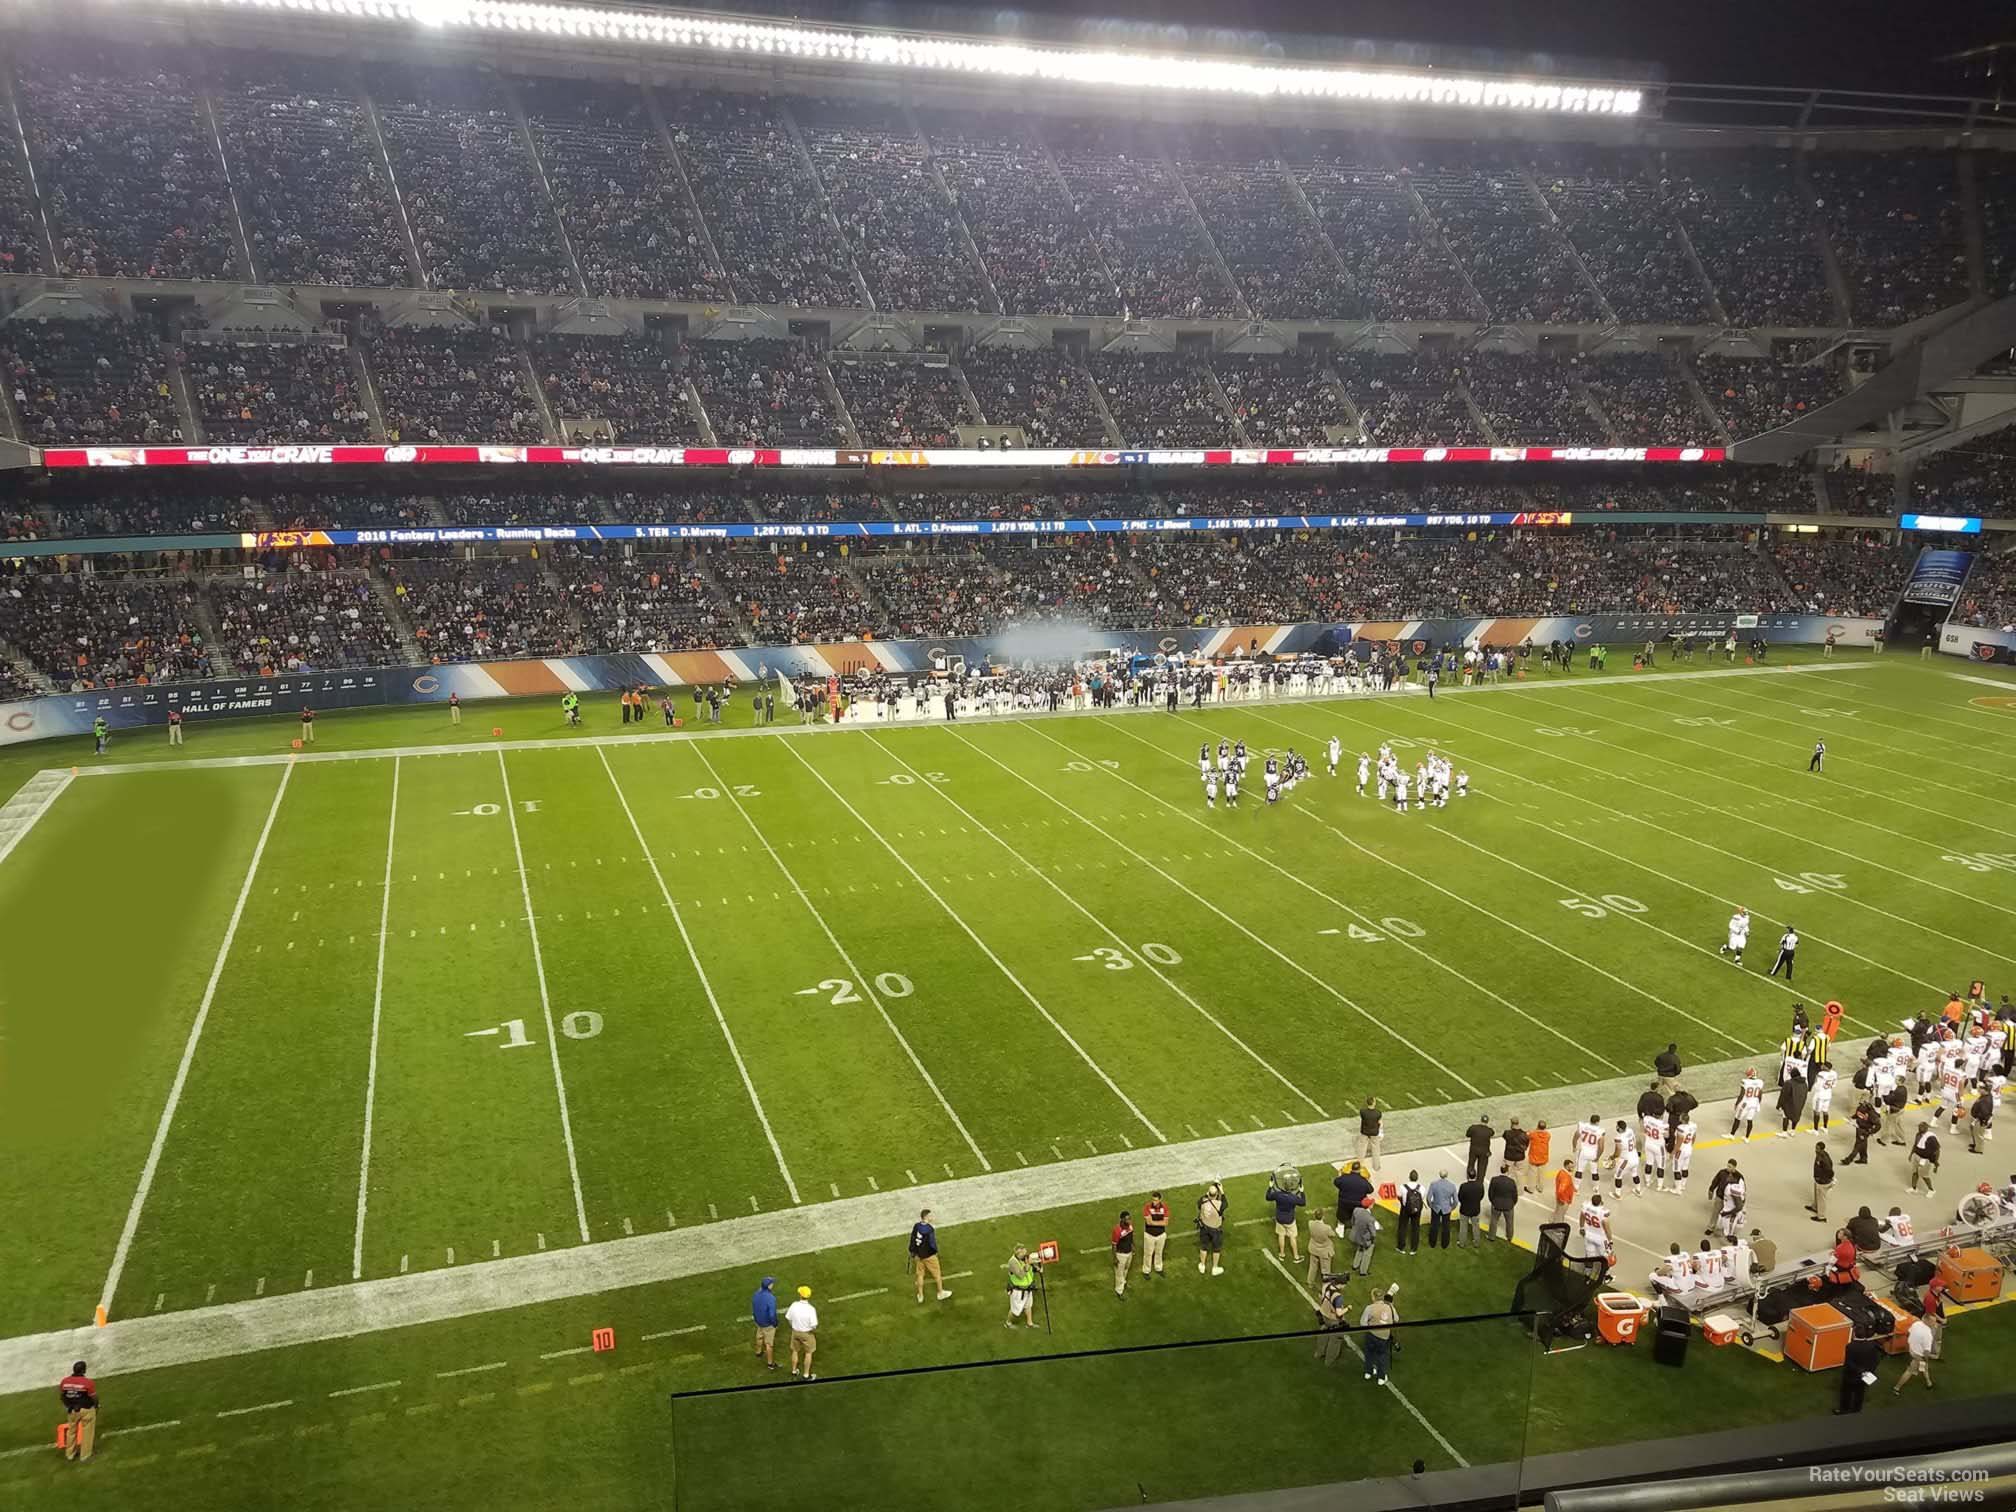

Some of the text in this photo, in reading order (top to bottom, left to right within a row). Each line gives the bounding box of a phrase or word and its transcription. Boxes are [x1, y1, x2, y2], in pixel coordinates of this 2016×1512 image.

[208, 448, 247, 464] ONE
[272, 447, 333, 463] CRAVE
[581, 448, 613, 463] ONE
[633, 448, 684, 463] CRAVE
[1018, 522, 1038, 532] YDS,
[1040, 521, 1051, 530] 11
[1053, 521, 1064, 530] TD
[1131, 521, 1145, 529] PHI
[1155, 520, 1191, 529] L.Blount
[1233, 519, 1252, 529] YDS,
[1267, 518, 1278, 527] TD
[1341, 517, 1358, 526] LAC
[1445, 515, 1464, 525] YDS,
[1479, 514, 1491, 523] TD
[357, 531, 387, 541] 2016
[390, 530, 435, 541] Fantasy
[438, 529, 484, 540] Leaders
[496, 528, 542, 540] Running
[544, 527, 576, 538] Backs
[636, 528, 645, 537] 5.
[648, 528, 669, 537] TEN
[680, 528, 727, 538] D.Murray
[782, 526, 805, 536] YDS,
[816, 526, 829, 535] TD
[905, 524, 920, 533] ATL
[931, 524, 979, 532] D.Freeman
[1946, 634, 1958, 643] GSH
[182, 699, 272, 713] HALL OF FAMERS
[1558, 895, 1649, 917] 50
[1944, 1072, 1958, 1087] 89
[1746, 1087, 1761, 1099] 80
[1581, 1131, 1597, 1146] 70
[1384, 1184, 1397, 1199] 30
[1584, 1213, 1601, 1229] 66
[1707, 1259, 1722, 1275] 77
[1617, 1318, 1635, 1336] G
[596, 1332, 611, 1349] 10
